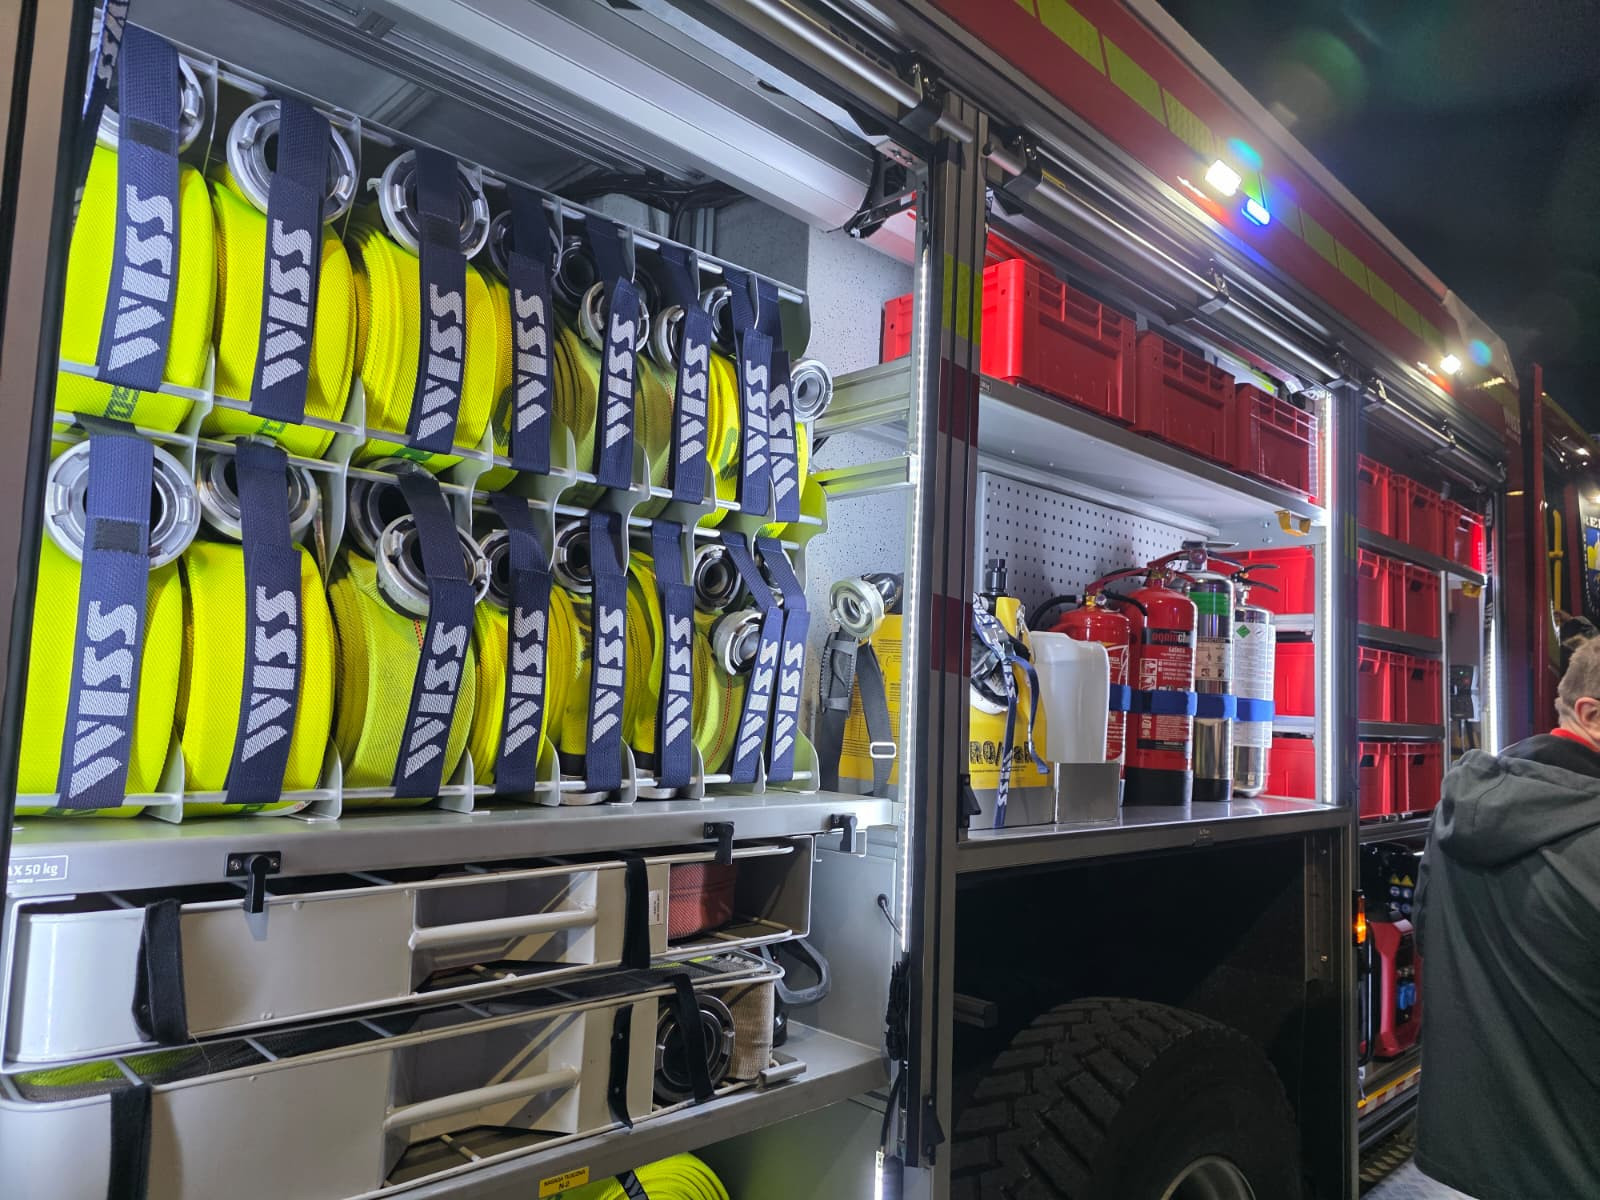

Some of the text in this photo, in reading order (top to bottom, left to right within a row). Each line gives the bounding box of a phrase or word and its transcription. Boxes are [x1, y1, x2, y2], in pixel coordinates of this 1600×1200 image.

[108, 183, 173, 371] WISS
[261, 219, 312, 390] WISS
[417, 282, 463, 441] WISS
[515, 288, 547, 433] WISS
[606, 313, 635, 448] WISS
[680, 338, 708, 465] WISS
[746, 360, 768, 477] WISS
[768, 383, 797, 502] WISS
[69, 600, 138, 798] WISS
[241, 585, 297, 763] WISS
[404, 621, 467, 779] WISS
[504, 606, 547, 757] WISS
[592, 606, 624, 743] WISS
[666, 614, 691, 747] WISS
[737, 639, 779, 762] WISS
[774, 640, 803, 762] WISS
[8, 862, 58, 877] AX 50 kg
